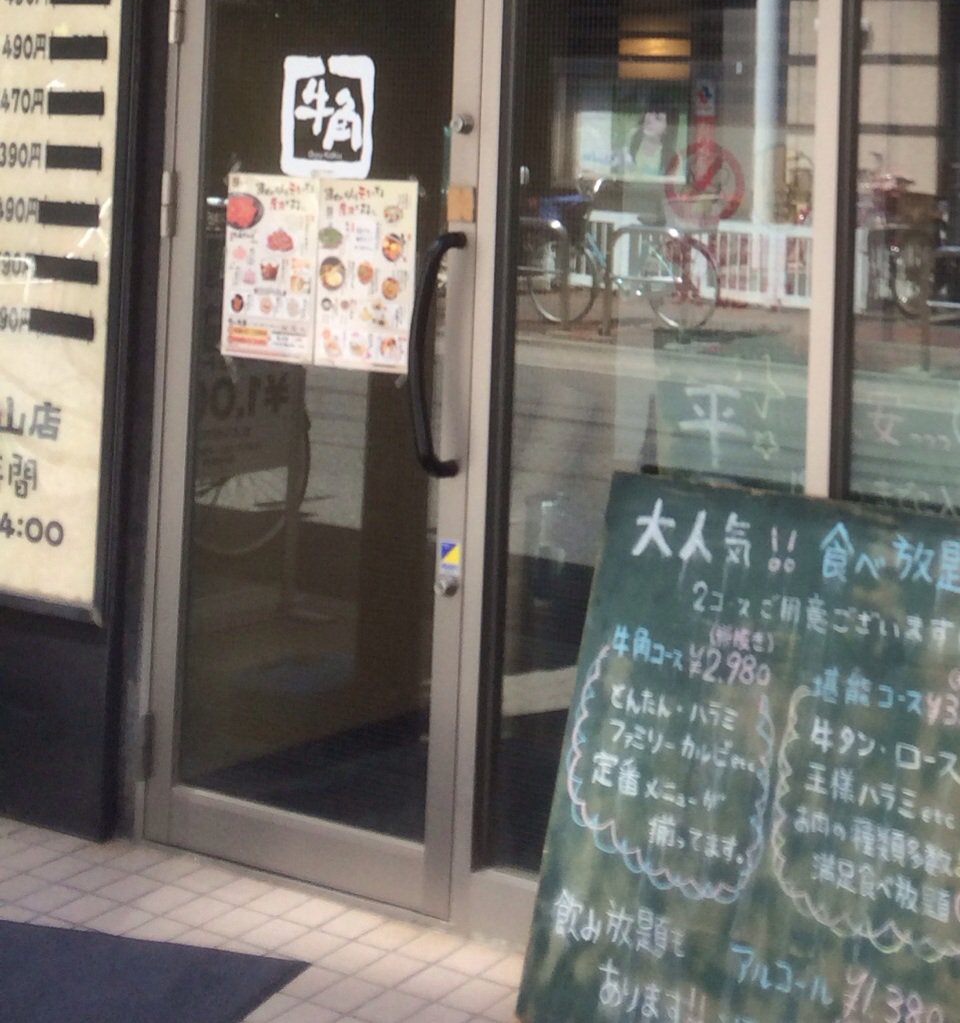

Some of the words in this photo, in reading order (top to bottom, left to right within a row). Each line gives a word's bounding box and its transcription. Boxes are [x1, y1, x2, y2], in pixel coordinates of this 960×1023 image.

[2, 33, 46, 60] 490円
[0, 88, 44, 114] 470円
[294, 77, 363, 152] 牛角
[0, 196, 39, 223] 90円
